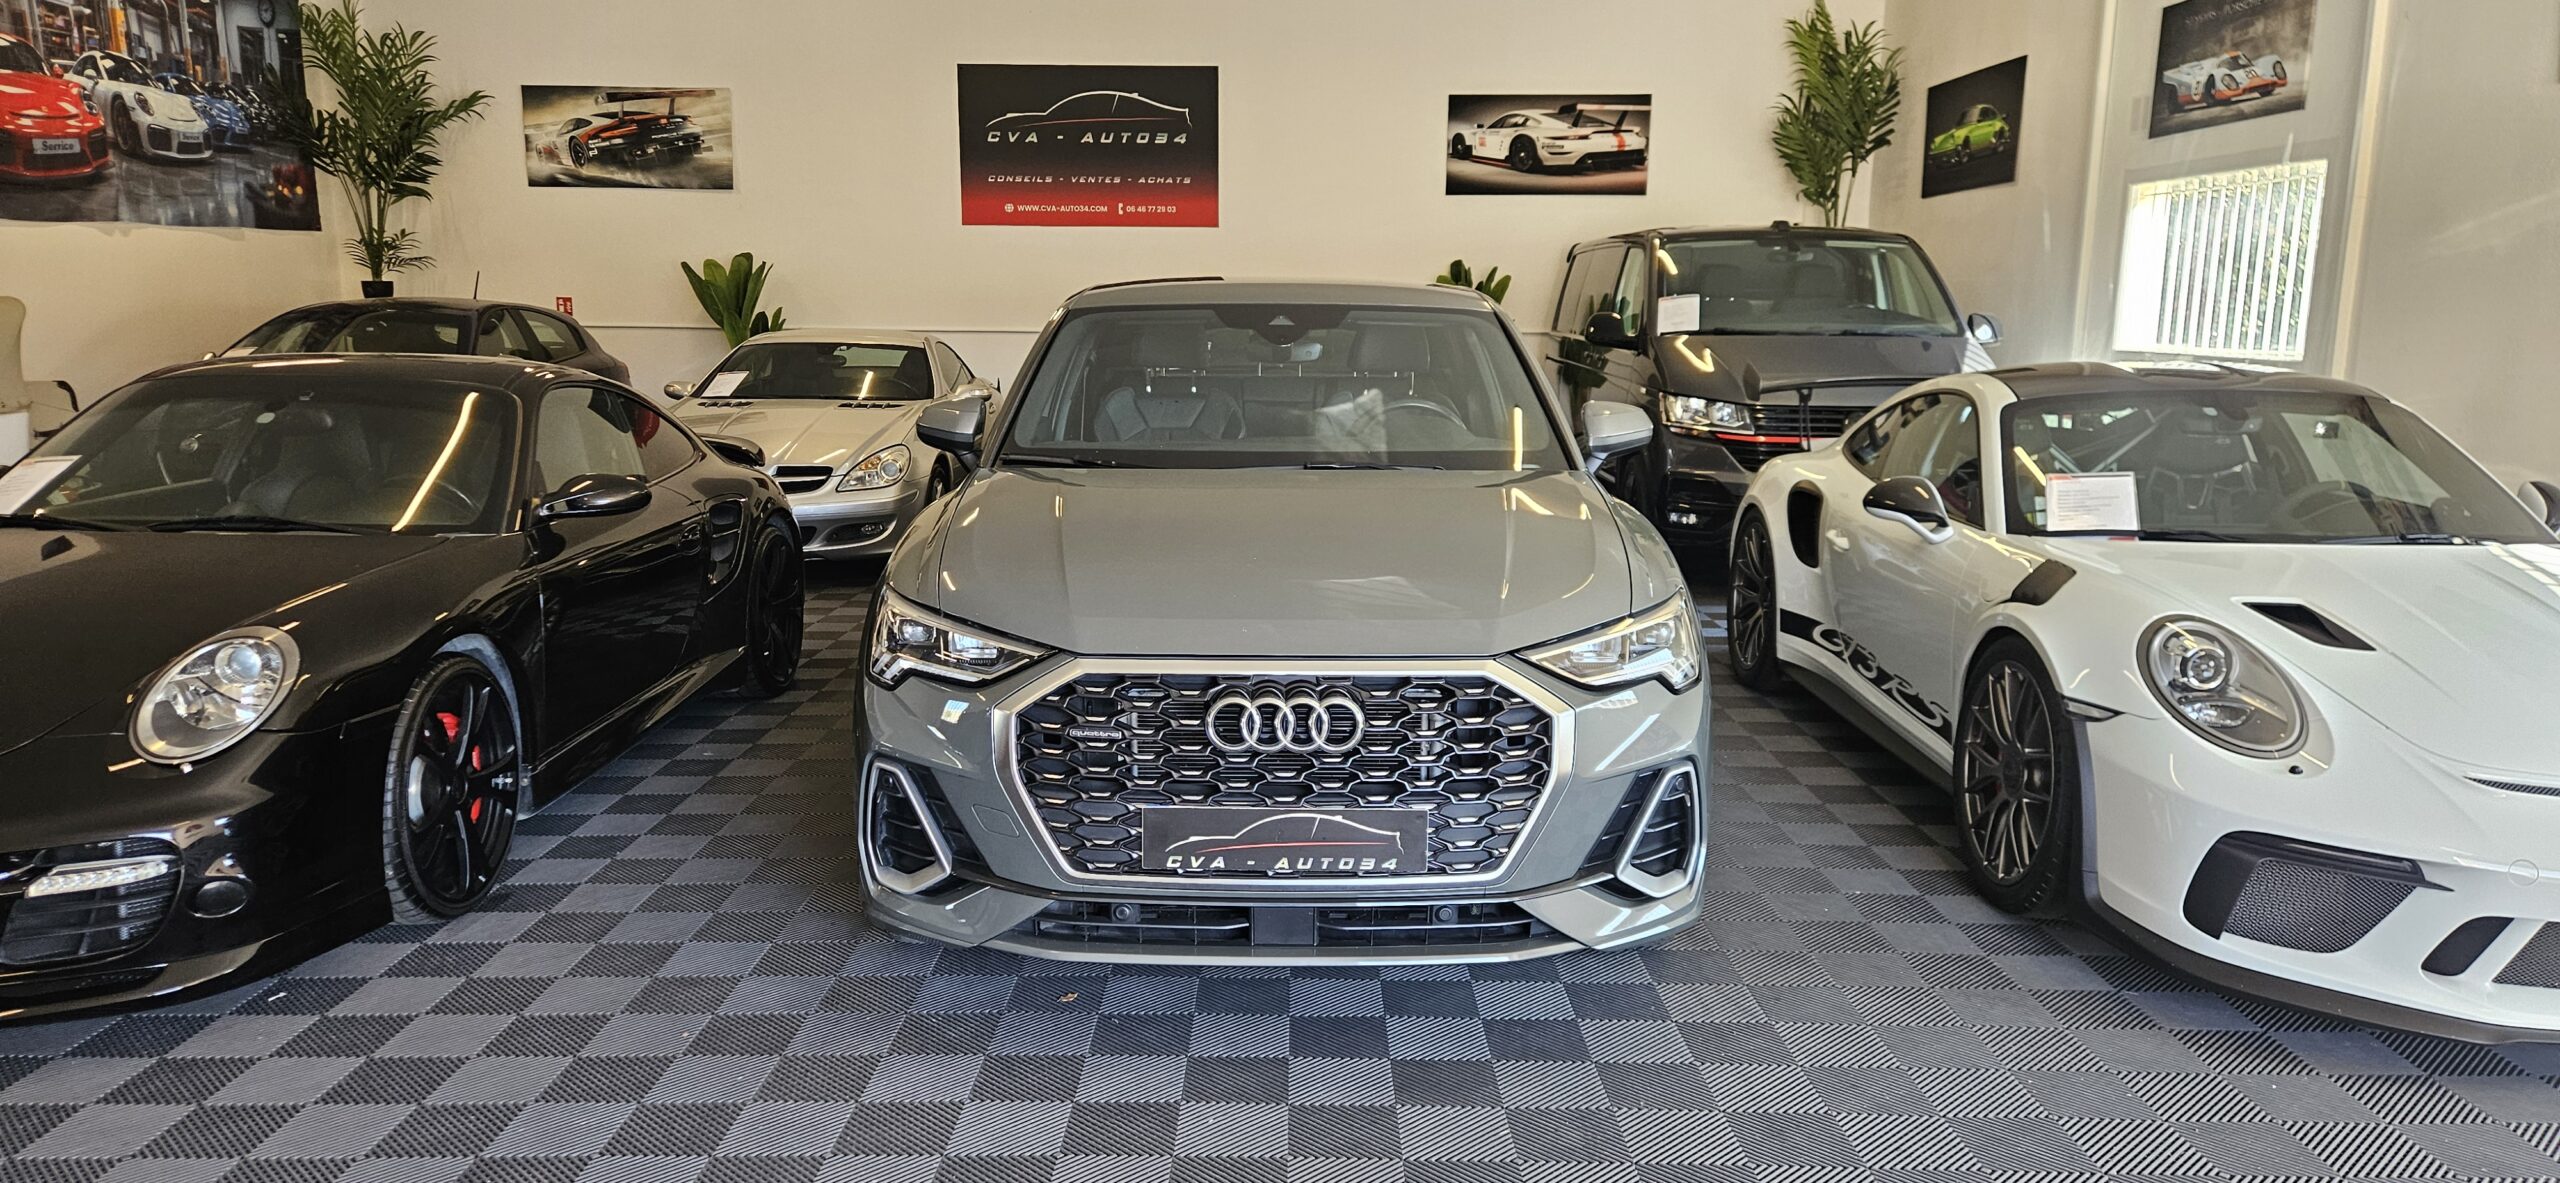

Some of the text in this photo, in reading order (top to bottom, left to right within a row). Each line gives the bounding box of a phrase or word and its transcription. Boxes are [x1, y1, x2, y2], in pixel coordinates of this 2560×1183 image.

[987, 131, 1038, 143] CVA
[1080, 131, 1187, 144] AUTO34
[988, 175, 1053, 183] CONSEILS
[1071, 175, 1121, 184] VENTES
[1137, 176, 1191, 184] ACHATS
[1017, 204, 1108, 212] WWW.CVA-AUTO34.COM
[1147, 205, 1156, 213] 77
[1167, 205, 1177, 213] 03
[1812, 624, 1951, 728] GT3 RS
[1072, 730, 1119, 738] quattro
[1166, 855, 1226, 869] CVA
[1274, 857, 1398, 870] AUTO34
